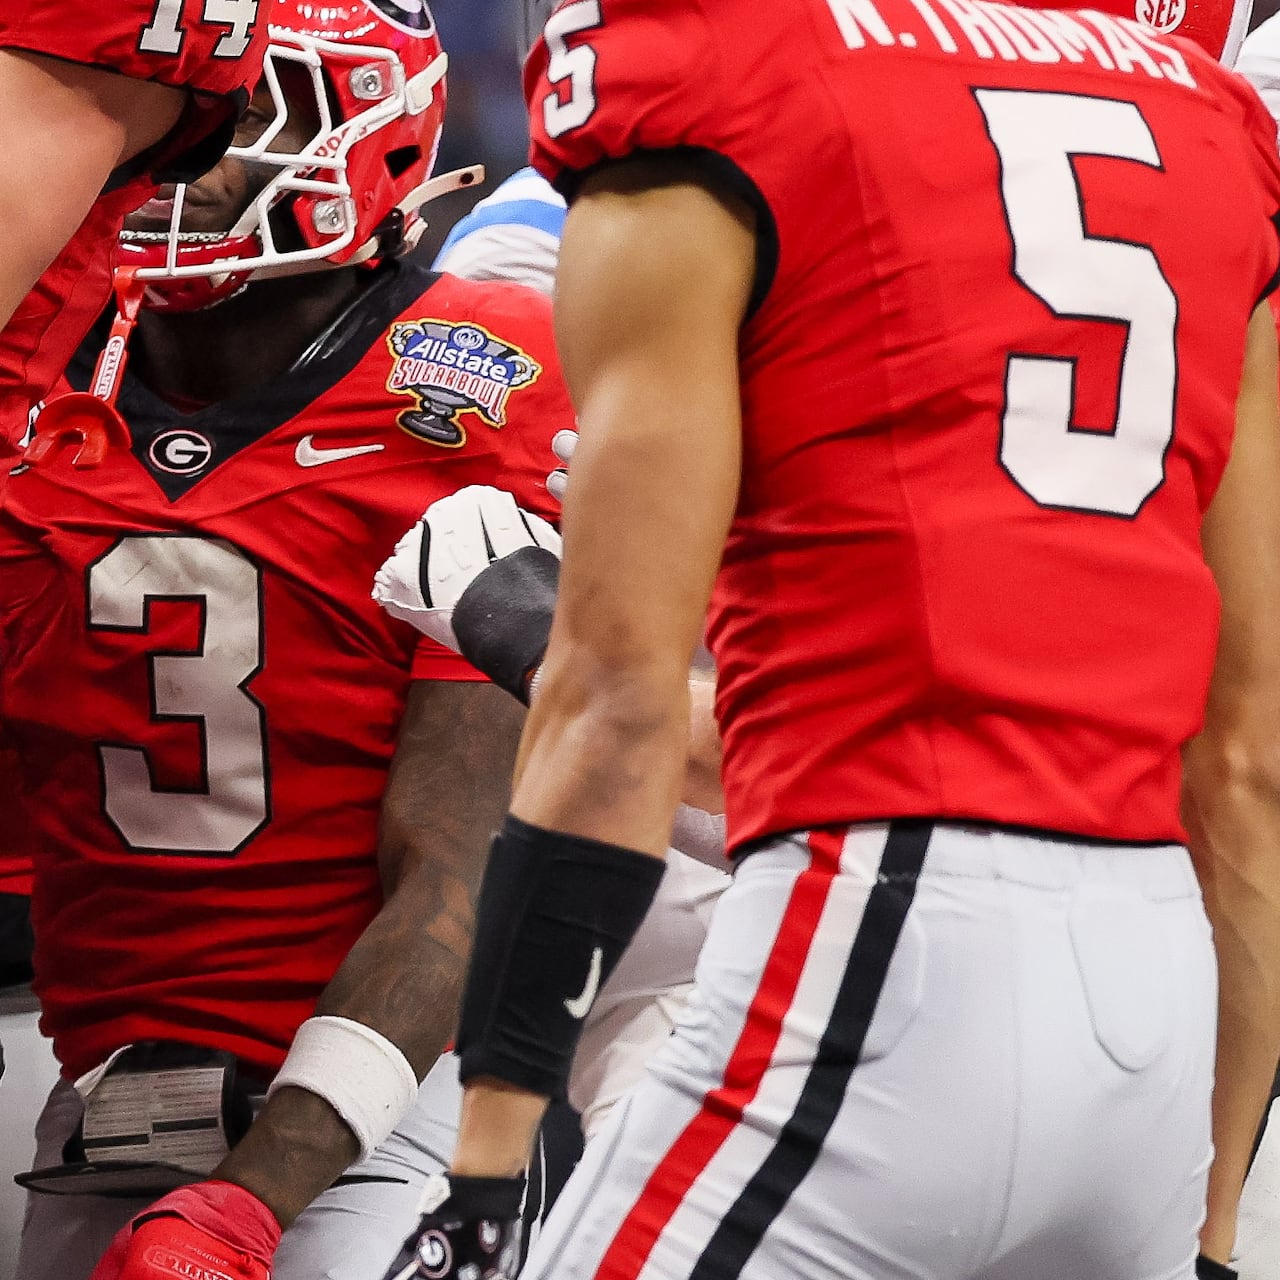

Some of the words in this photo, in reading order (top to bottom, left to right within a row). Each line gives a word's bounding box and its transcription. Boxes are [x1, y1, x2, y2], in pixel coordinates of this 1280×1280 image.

[151, 431, 210, 472] G
[970, 86, 1179, 520] 5
[83, 531, 272, 858] 3
